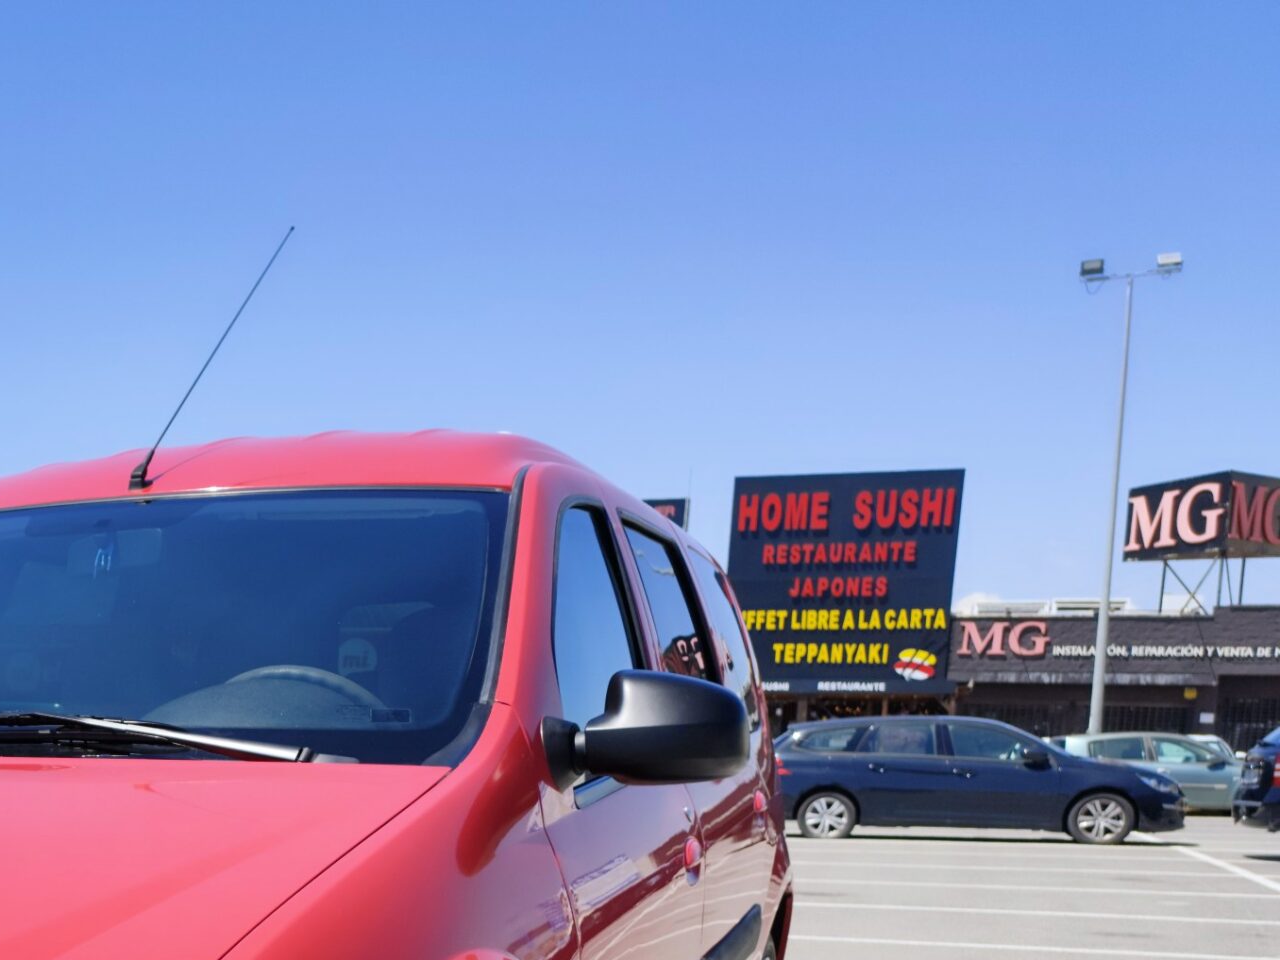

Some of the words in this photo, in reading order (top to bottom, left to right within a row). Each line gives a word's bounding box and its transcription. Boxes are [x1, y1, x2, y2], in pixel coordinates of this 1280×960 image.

[737, 492, 830, 532] HOME
[852, 487, 956, 530] SUSHI
[1124, 482, 1225, 552] MG
[762, 541, 917, 565] RESTAURANTE
[788, 576, 888, 598] JAPONES
[791, 609, 840, 631] LIBRE
[842, 608, 855, 630] A
[858, 608, 882, 630] LA
[884, 608, 947, 630] CARTA
[956, 620, 1051, 657] MG
[1052, 643, 1129, 657] INSTALAÓN,
[1131, 644, 1204, 657] REPARACIÓN
[1206, 646, 1215, 657] Y
[1216, 646, 1254, 657] VENTA
[1256, 646, 1271, 657] DE
[773, 643, 889, 664] TEPPANYAKI
[817, 681, 886, 692] RESTAURANTE
